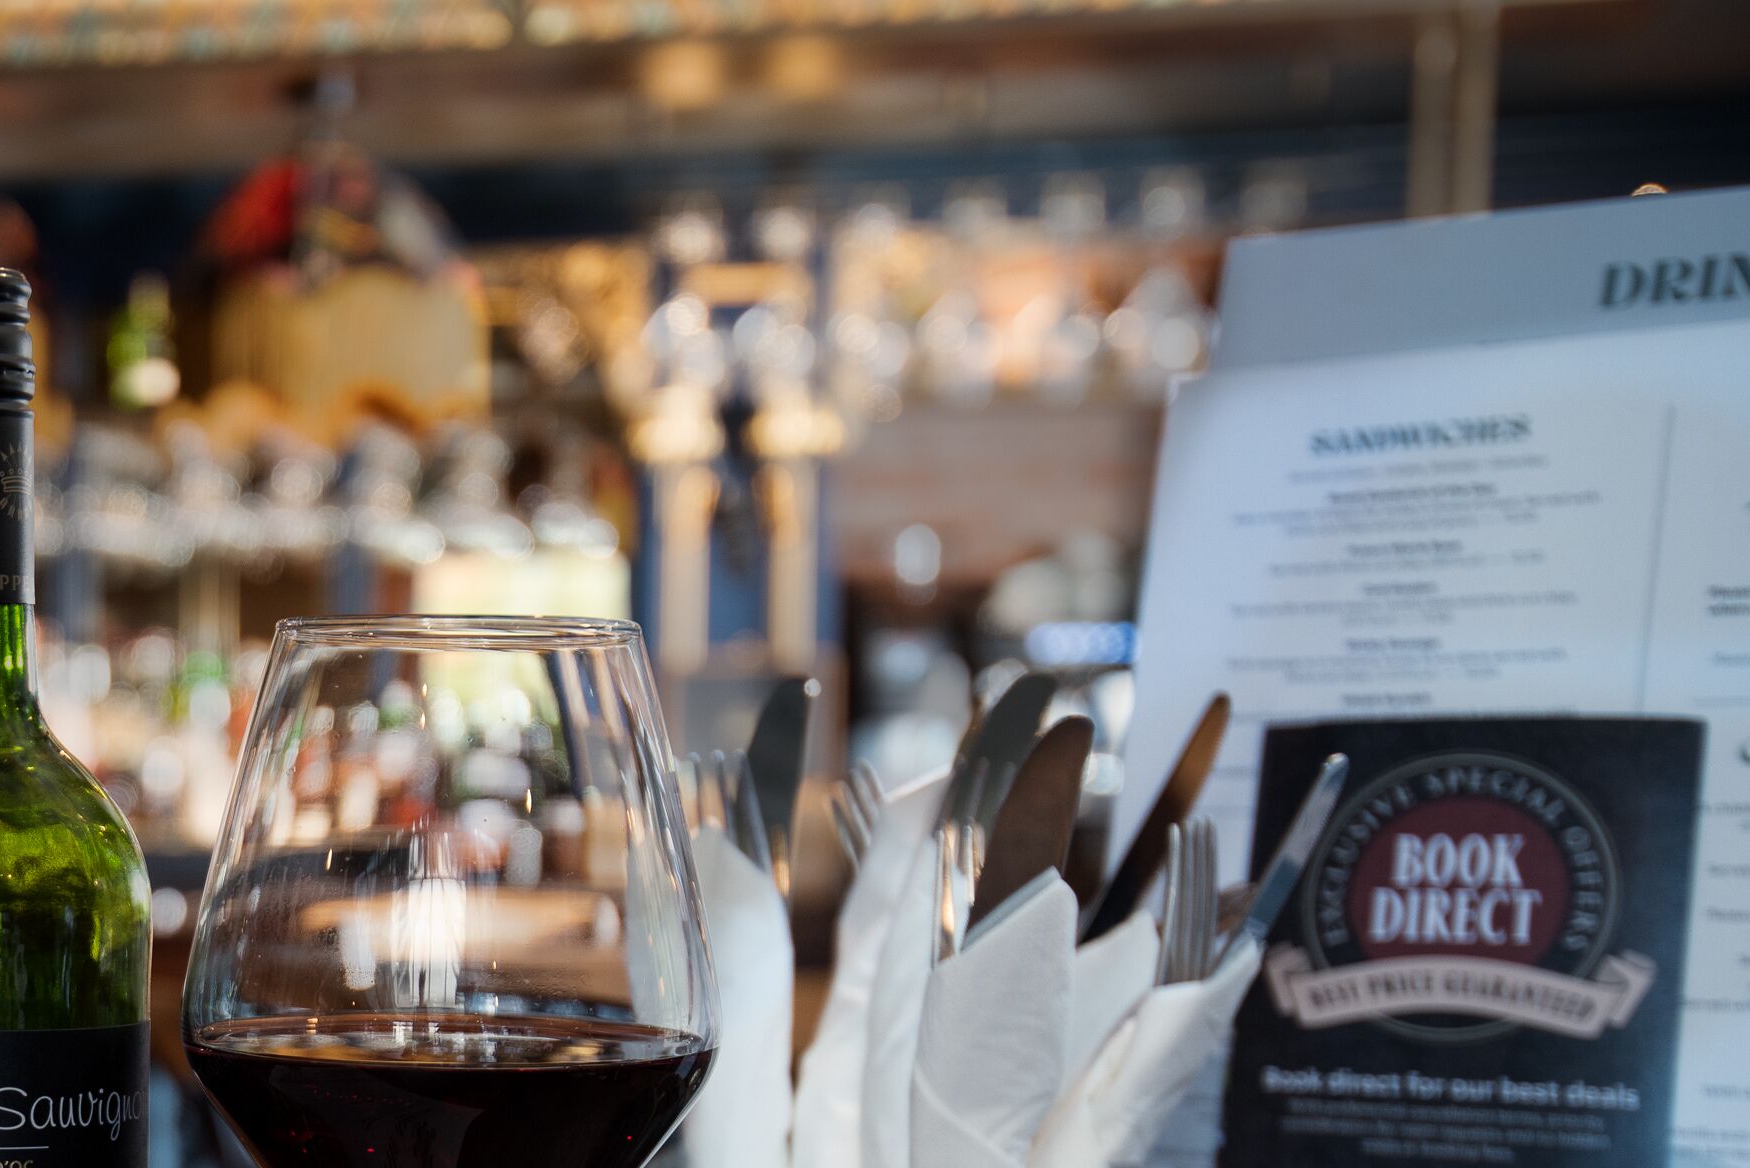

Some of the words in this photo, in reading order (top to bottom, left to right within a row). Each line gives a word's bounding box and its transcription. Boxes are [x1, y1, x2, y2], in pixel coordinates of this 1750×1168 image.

[1391, 832, 1525, 888] BOOK
[1369, 886, 1543, 945] DIRECT
[1367, 970, 1434, 996] PRICE
[1261, 1065, 1322, 1093] Book
[1327, 1068, 1401, 1096] direct
[1404, 1070, 1444, 1099] for
[1450, 1076, 1494, 1102] our
[1499, 1075, 1559, 1106] best
[1565, 1080, 1641, 1112] deals
